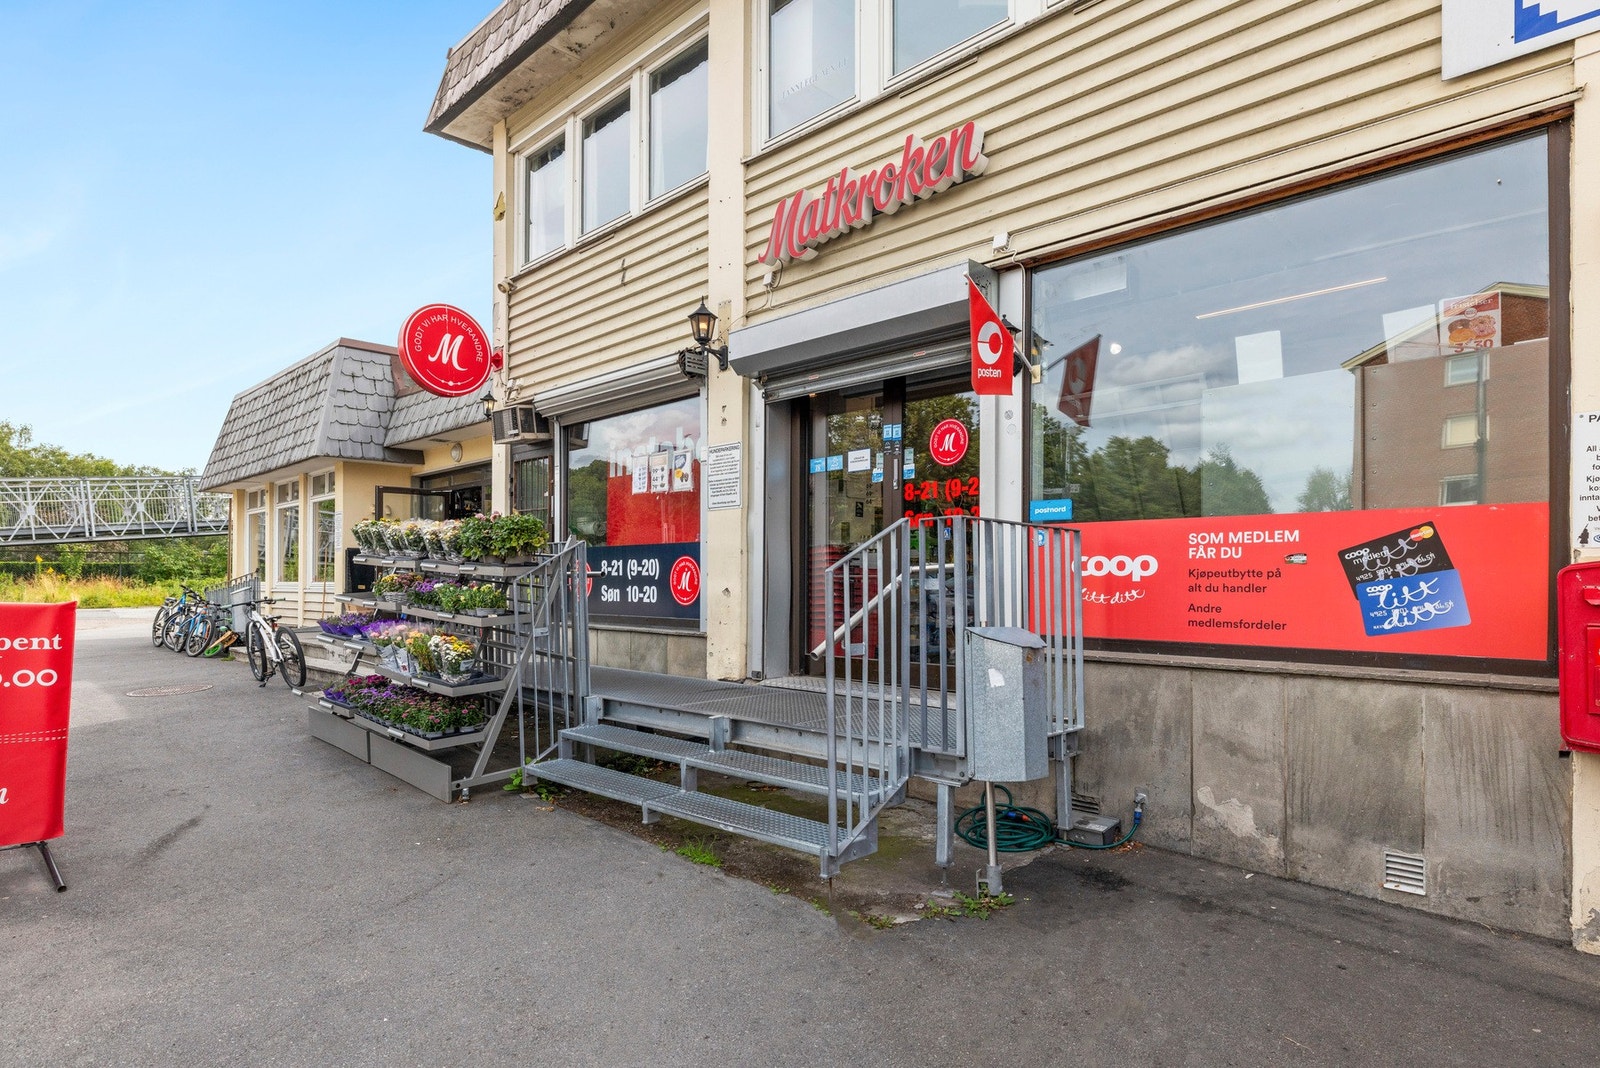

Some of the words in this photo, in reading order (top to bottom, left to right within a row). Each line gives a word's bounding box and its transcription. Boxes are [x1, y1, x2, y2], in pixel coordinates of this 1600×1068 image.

[757, 120, 983, 263] Matkroken
[414, 326, 425, 352] GODT
[422, 319, 431, 328] VI
[430, 314, 449, 323] HAR
[450, 316, 484, 363] HVERANDRE
[428, 333, 469, 372] M
[977, 366, 1002, 379] posten
[938, 431, 957, 452] M
[903, 482, 939, 501] 8-21
[944, 476, 980, 503] (9-2
[1034, 506, 1068, 515] postnord
[1188, 532, 1224, 545] SOM
[1228, 529, 1300, 544] MEDLEM
[1188, 545, 1217, 559] FÅR
[1220, 546, 1242, 559] DU
[1344, 547, 1371, 560] coop
[601, 559, 623, 577] 8-21
[627, 558, 660, 580] (9-20)
[1071, 554, 1159, 582] coop
[1188, 568, 1263, 580] Kjøpeutbytte
[1266, 568, 1282, 580] på
[677, 570, 692, 592] M
[1188, 583, 1202, 593] alt
[1205, 583, 1219, 593] du
[1222, 583, 1267, 593] handler
[1366, 583, 1394, 593] coop
[601, 585, 620, 602] Søn
[626, 585, 658, 603] 10-20
[1188, 603, 1222, 614] Andre
[1188, 618, 1287, 631] medlemsfordeler
[0, 668, 58, 688] .00
